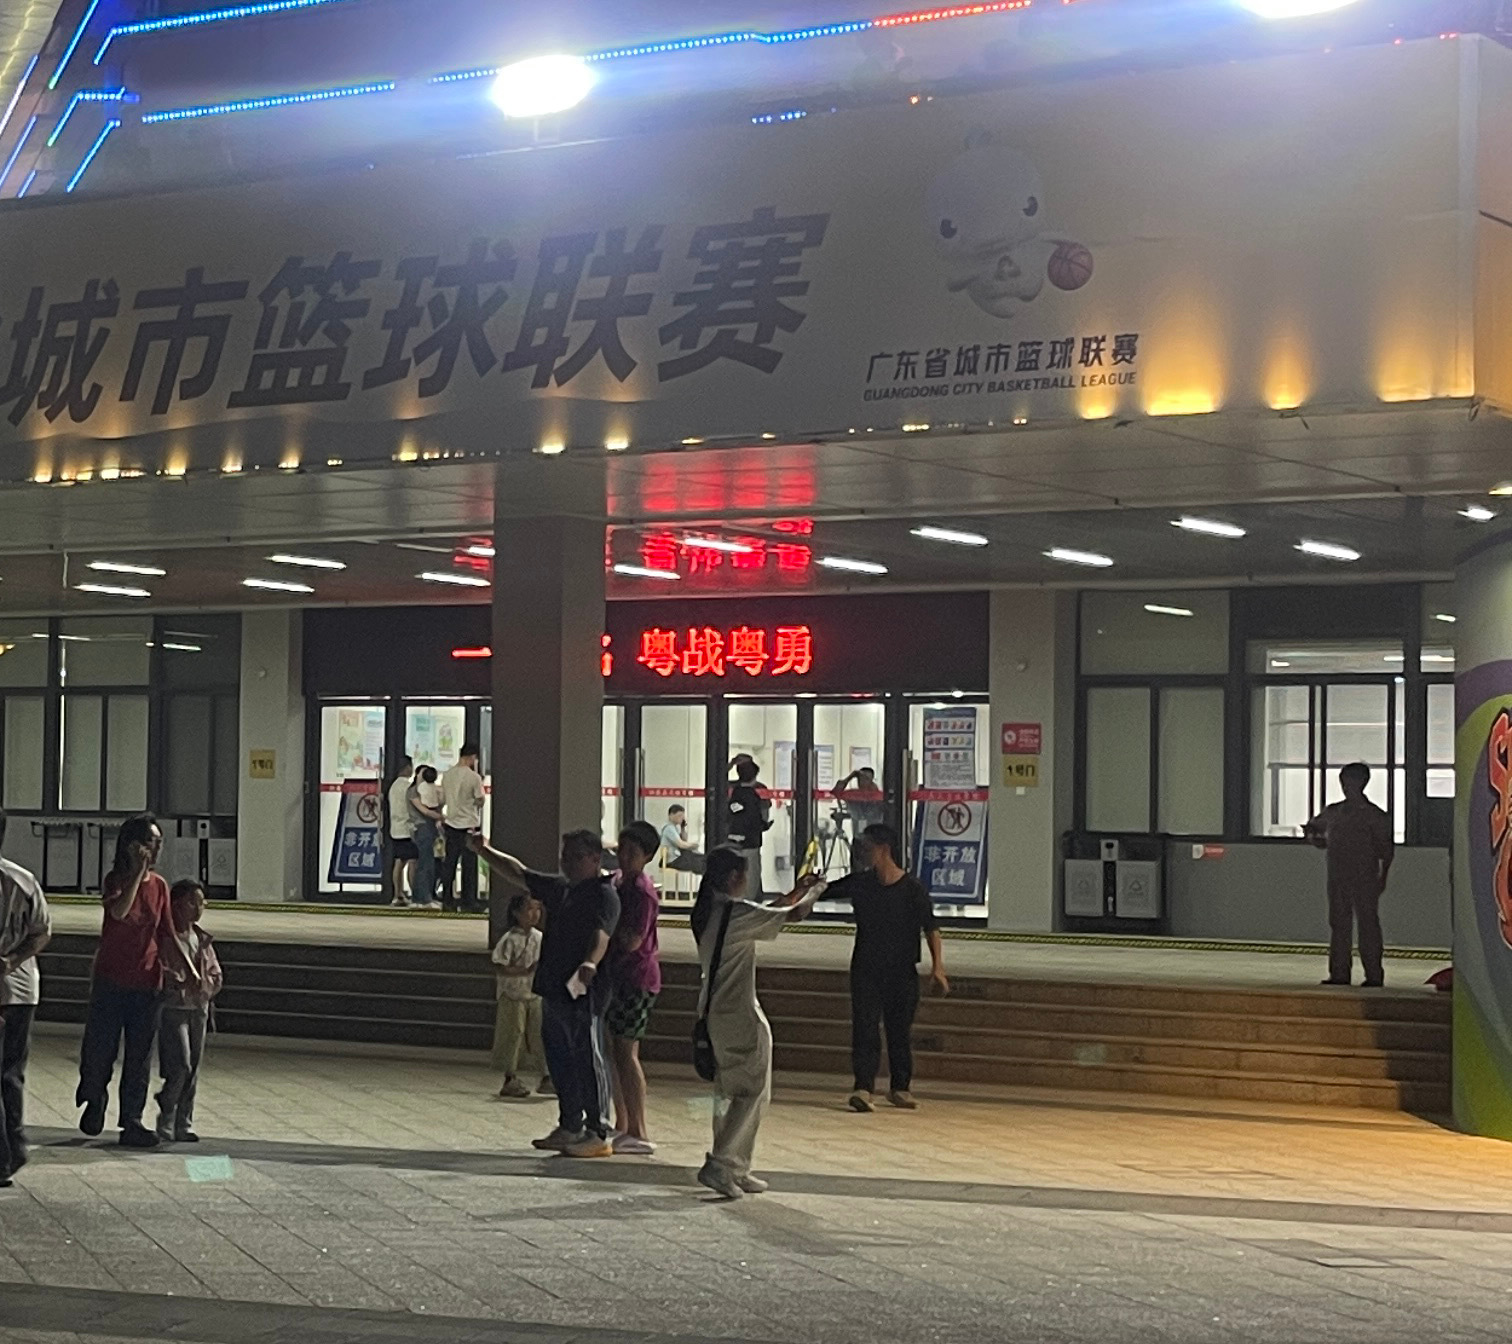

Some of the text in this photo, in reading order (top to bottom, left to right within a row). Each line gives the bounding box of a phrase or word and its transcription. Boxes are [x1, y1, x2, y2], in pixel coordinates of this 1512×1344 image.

[866, 333, 1139, 383] 广东省城市篮球联赛
[863, 371, 1137, 402] GUANGDONG CITY BASKETBALL LEAGUE
[638, 626, 813, 676] 粤战粤勇
[924, 845, 977, 864] 非开放
[931, 869, 965, 886] 区域
